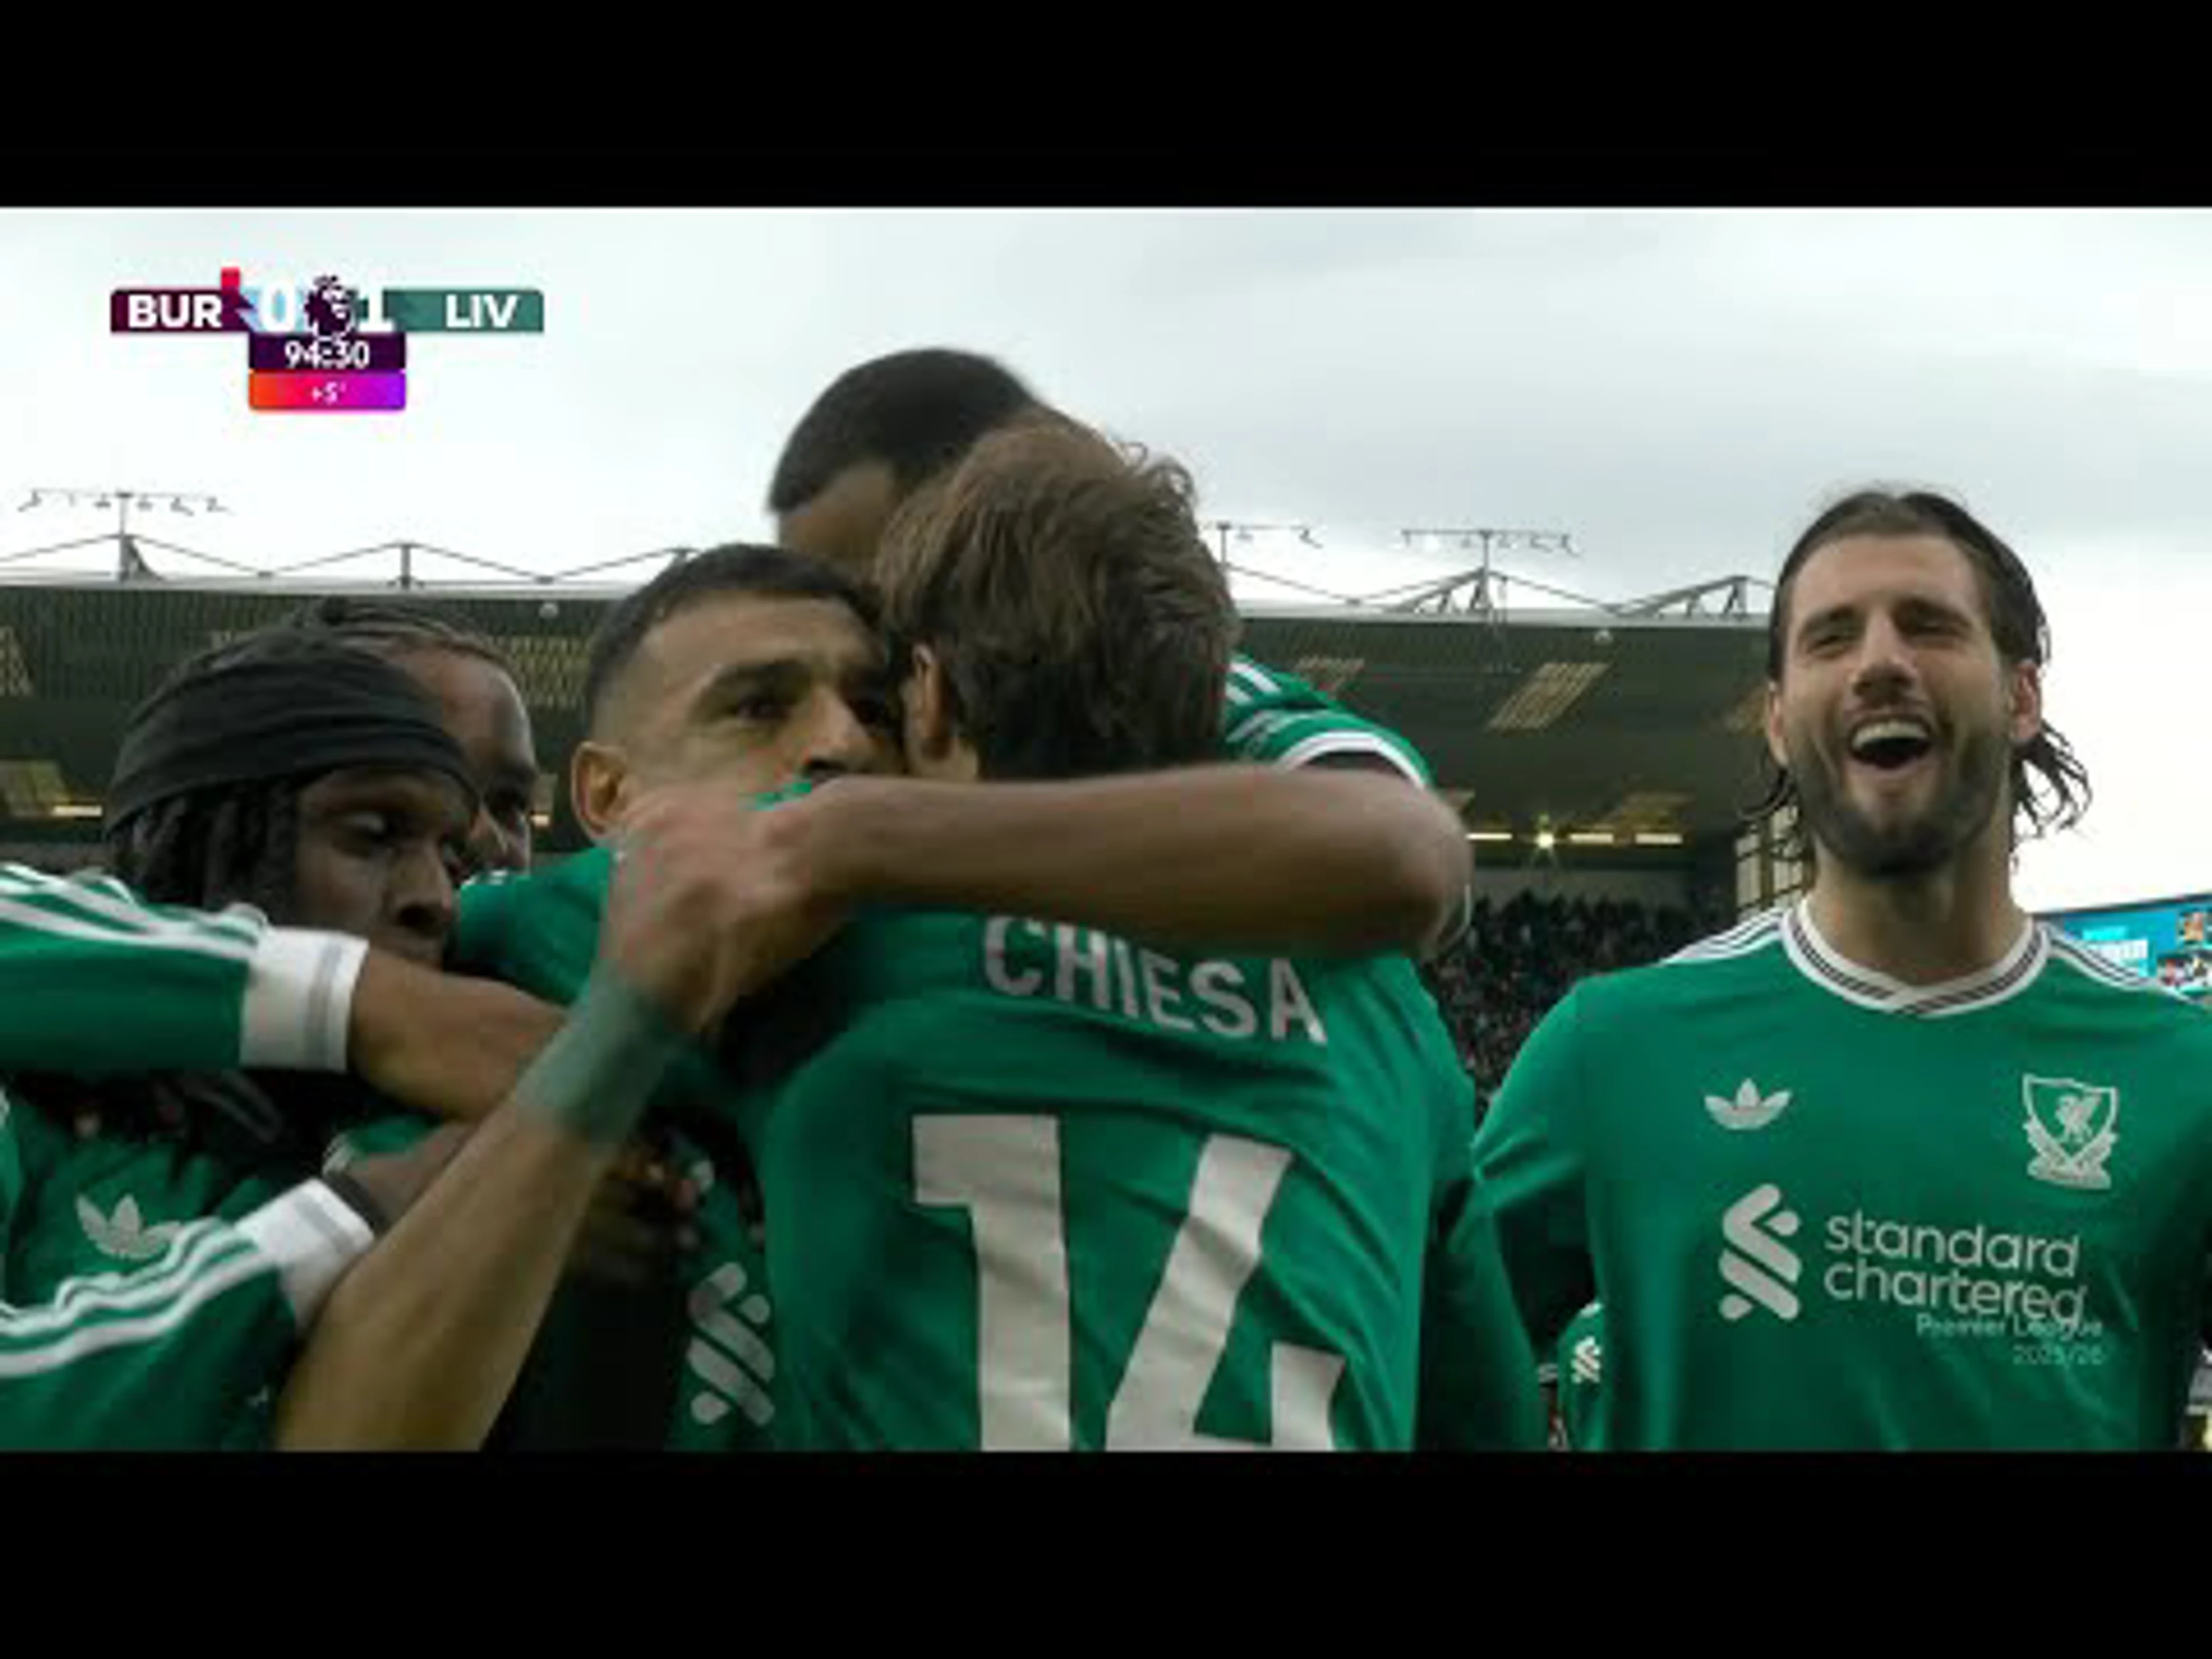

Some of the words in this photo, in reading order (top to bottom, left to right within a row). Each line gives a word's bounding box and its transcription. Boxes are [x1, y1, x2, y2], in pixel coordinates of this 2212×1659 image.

[982, 915, 1328, 1046] CHIESA
[912, 1114, 1347, 1451] 14
[1824, 1207, 2080, 1278] standard
[1823, 1259, 2089, 1328] chartered
